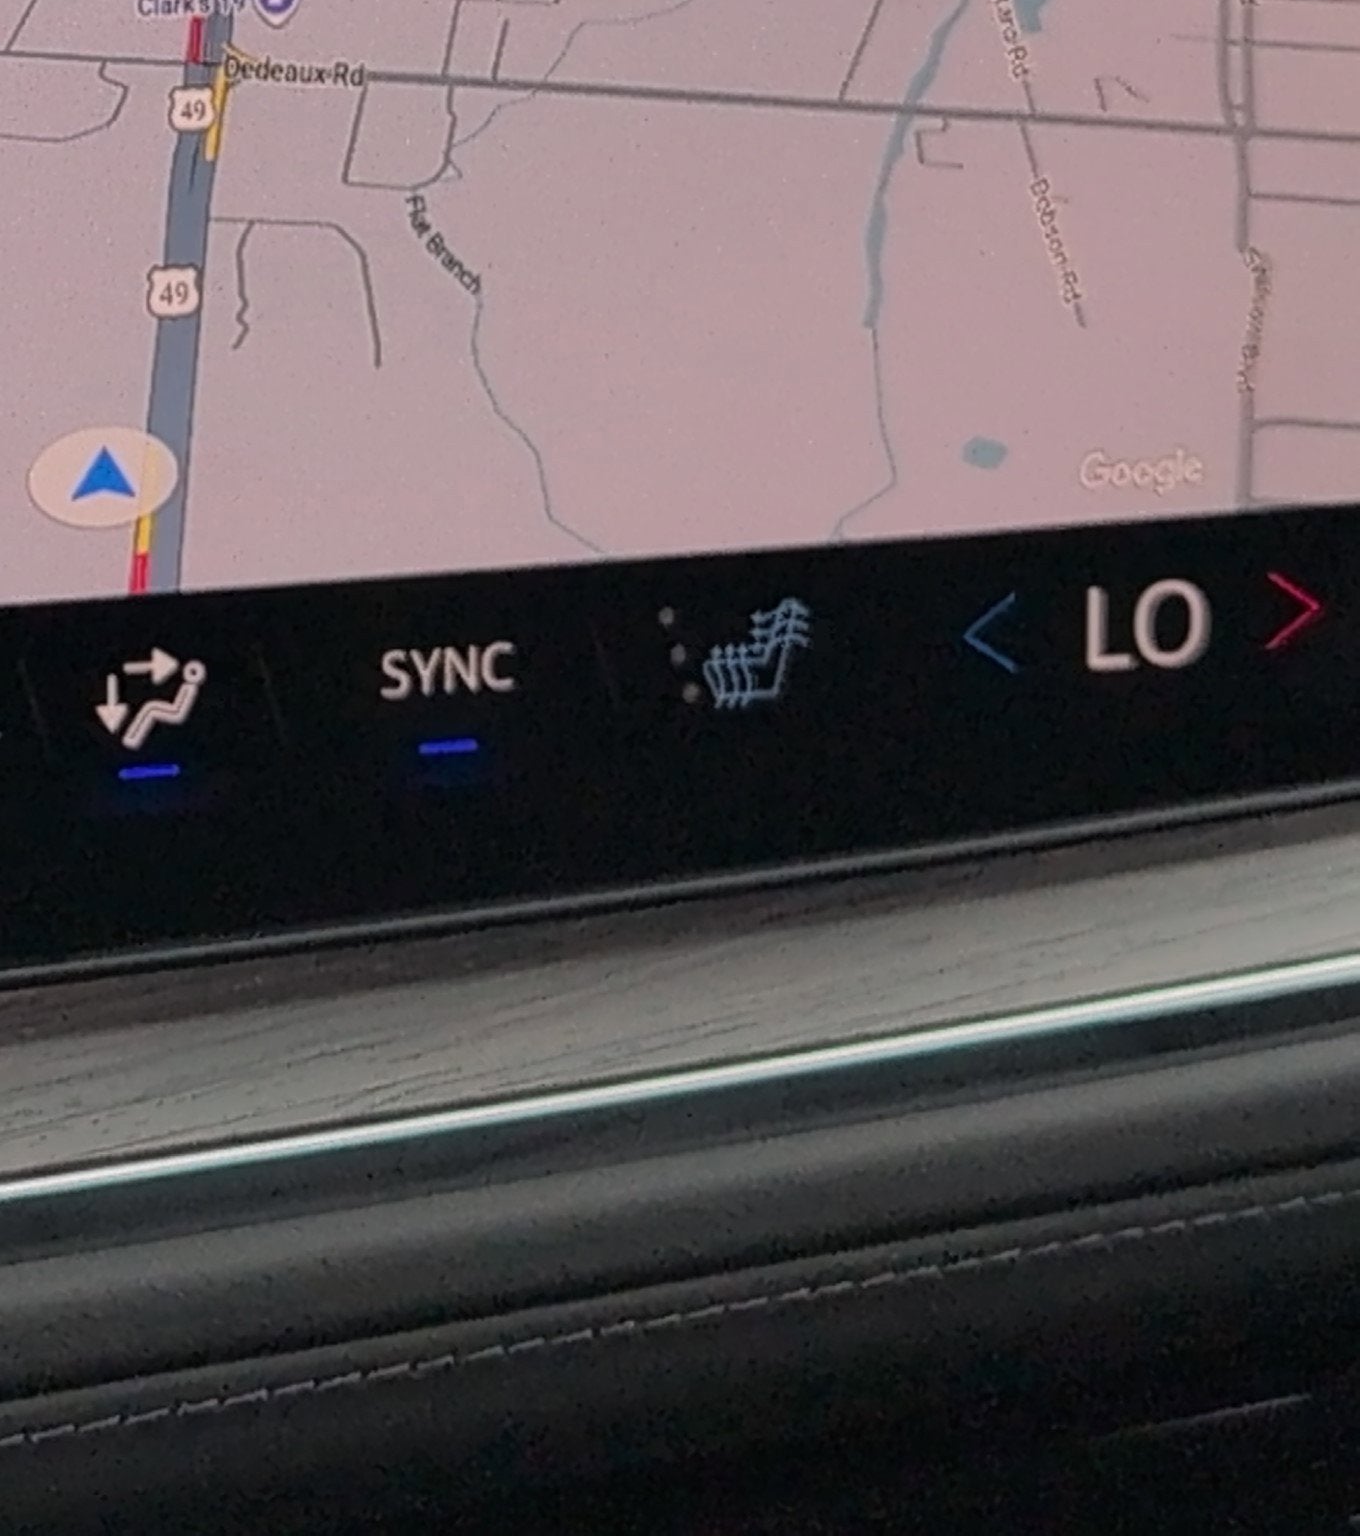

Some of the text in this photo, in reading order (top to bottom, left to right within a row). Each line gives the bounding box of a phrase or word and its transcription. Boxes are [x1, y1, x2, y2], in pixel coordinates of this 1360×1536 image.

[223, 55, 365, 87] Dedeaux Rd
[179, 100, 206, 120] 49
[423, 236, 484, 295] Branch
[158, 283, 189, 304] 49
[1079, 448, 1205, 495] Google
[1081, 577, 1215, 676] LO
[380, 640, 517, 701] SYNC
